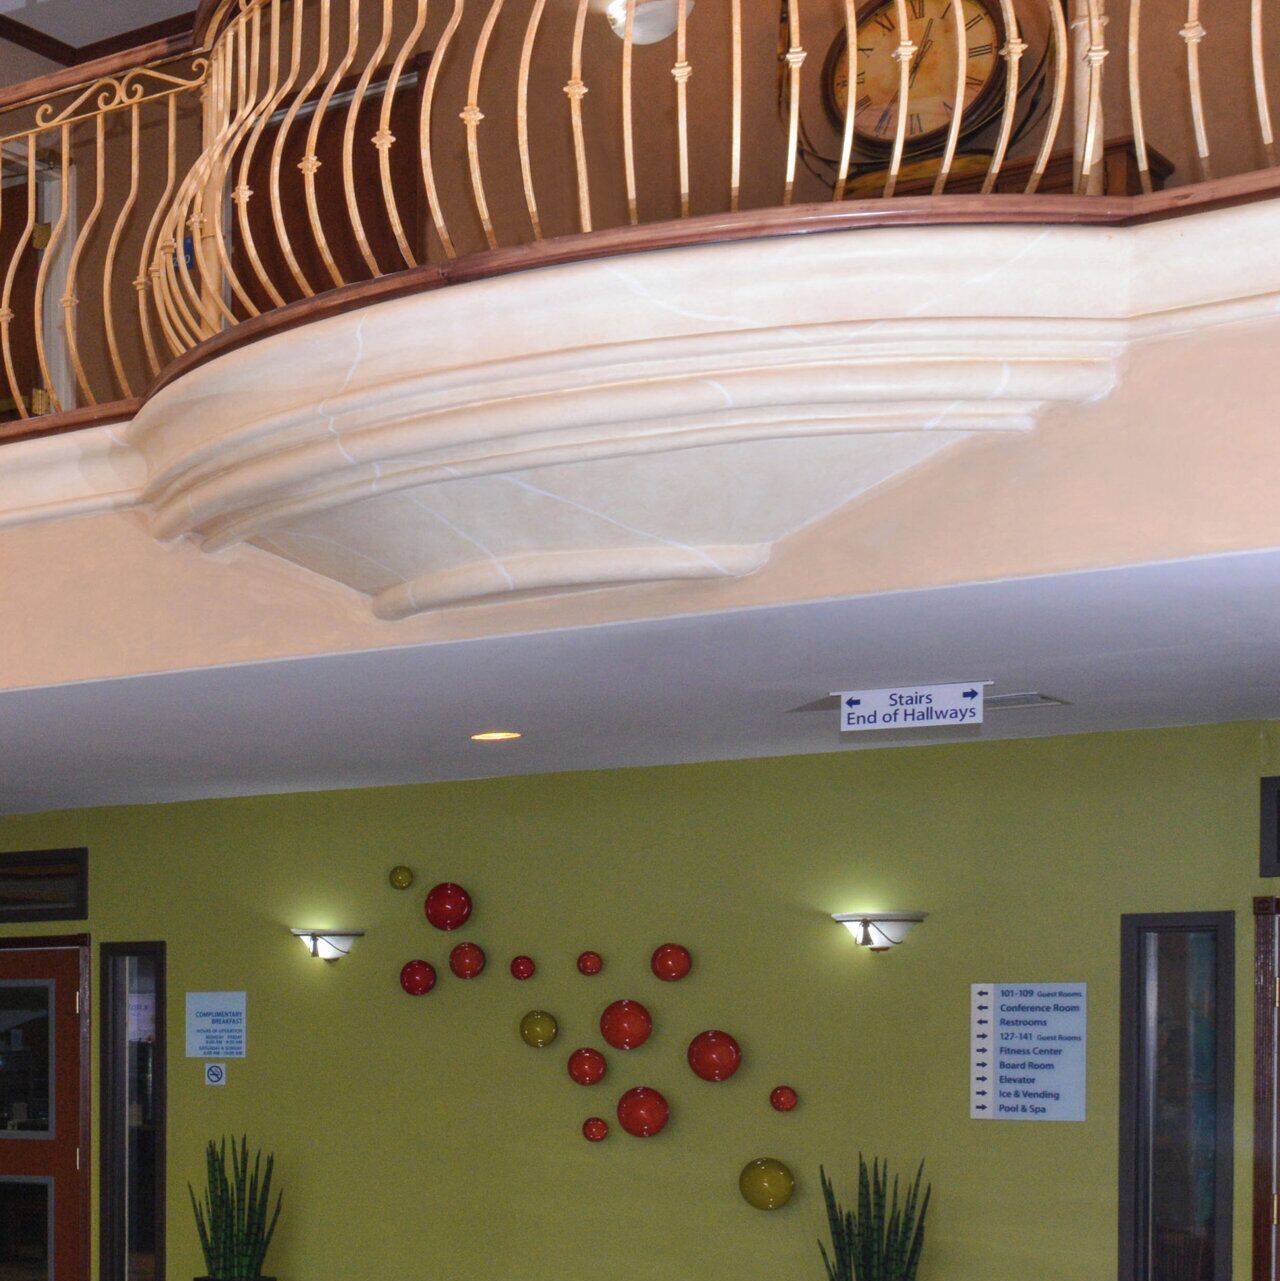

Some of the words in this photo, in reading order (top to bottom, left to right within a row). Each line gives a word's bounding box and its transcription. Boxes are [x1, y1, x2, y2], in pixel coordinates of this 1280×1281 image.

[889, 691, 933, 706] Stairs
[847, 710, 877, 725] End
[882, 708, 899, 723] of
[904, 706, 976, 722] Hallways
[1000, 1004, 1051, 1012] Conference
[1053, 1004, 1080, 1012] Room
[1000, 1018, 1047, 1026] Restrooms
[1000, 1047, 1031, 1055] Fitness
[1033, 1047, 1063, 1055] Center
[999, 1061, 1026, 1069] Board
[1028, 1061, 1054, 1069] Room
[999, 1075, 1036, 1083] Elevator
[999, 1090, 1012, 1098] Ice
[1013, 1090, 1020, 1098] &
[1022, 1090, 1060, 1100] Vending
[999, 1104, 1019, 1112] Pool
[1029, 1105, 1046, 1114] Spa
